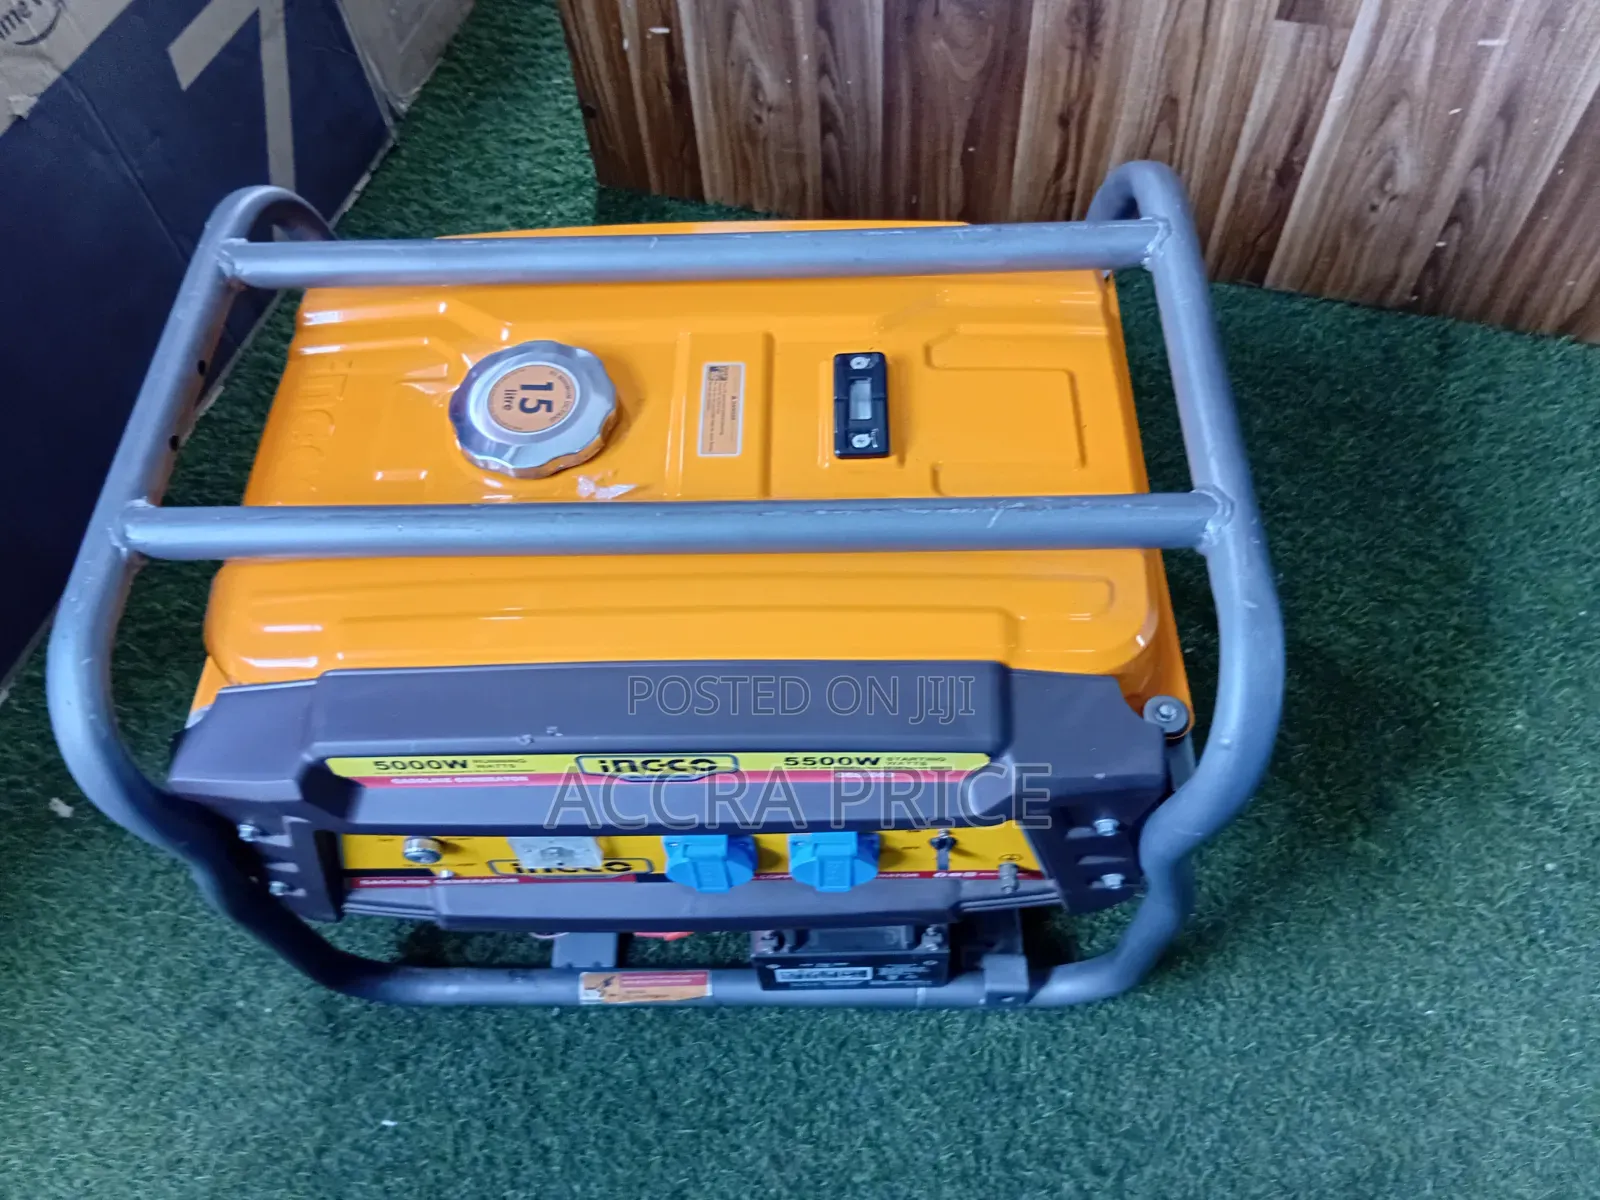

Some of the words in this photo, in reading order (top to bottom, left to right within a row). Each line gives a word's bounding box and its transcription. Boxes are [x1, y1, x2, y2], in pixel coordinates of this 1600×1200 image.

[502, 388, 518, 411] litre
[518, 381, 554, 414] 15
[373, 759, 468, 771] 5000W
[784, 756, 880, 766] 5500W
